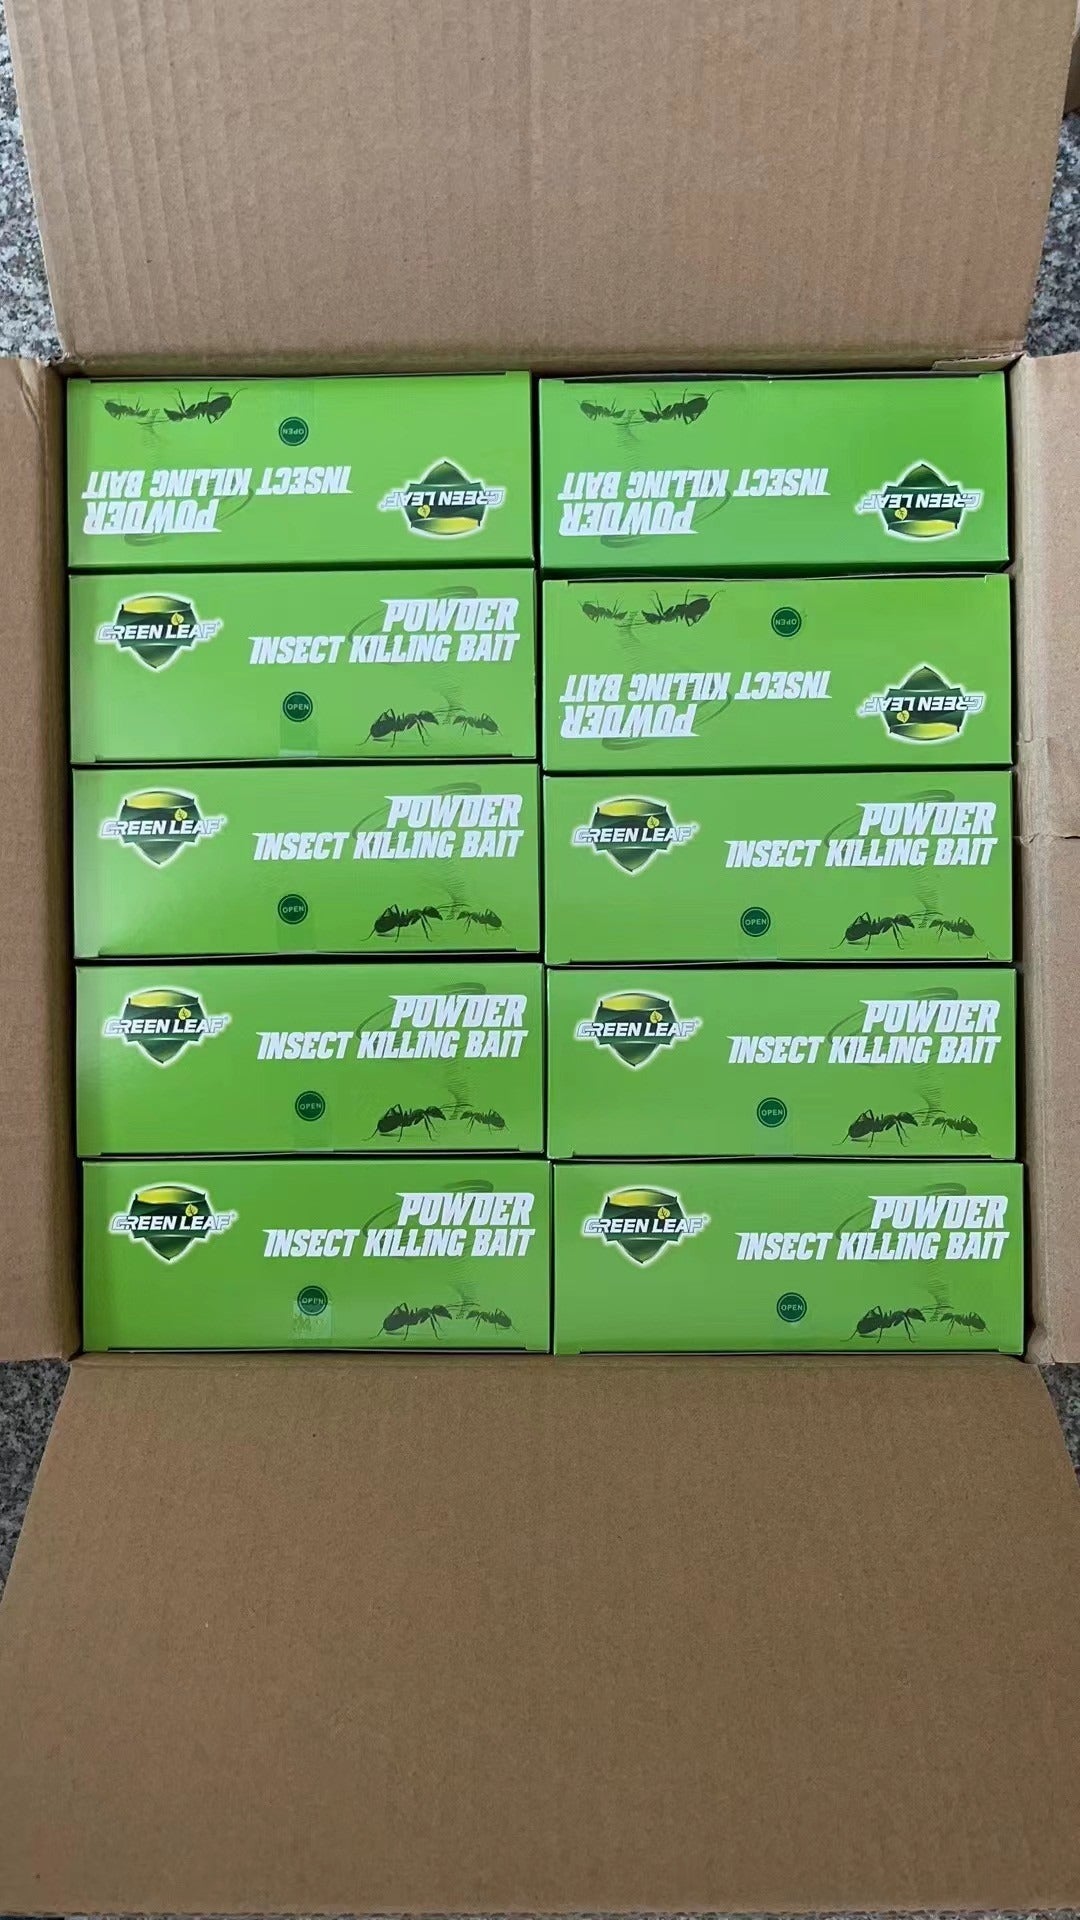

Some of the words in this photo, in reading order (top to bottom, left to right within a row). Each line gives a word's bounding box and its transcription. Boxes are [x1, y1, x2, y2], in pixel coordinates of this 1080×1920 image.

[81, 470, 144, 498] BAIT
[152, 468, 252, 496] KILLING
[256, 466, 352, 494] INSECT
[558, 472, 619, 500] BAIT
[627, 470, 729, 498] KILLING
[734, 468, 830, 496] INSECT
[382, 490, 436, 507] LEAF
[438, 490, 504, 506] GREEN
[859, 493, 912, 510] LEAF
[915, 493, 981, 509] GREEN
[83, 499, 221, 534] POWDER
[559, 501, 697, 536] POWDER
[380, 598, 519, 632] POWDER
[98, 624, 163, 640] GREEN
[165, 623, 215, 639] LEAF
[249, 636, 344, 664] INSECT
[348, 634, 452, 663] KILLING
[457, 633, 520, 661] BAIT
[560, 674, 624, 702] BAIT
[628, 672, 730, 701] KILLING
[735, 671, 832, 699] INSECT
[863, 696, 916, 713] LEAF
[918, 696, 984, 712] GREEN
[561, 704, 699, 738] POWDER
[384, 795, 523, 828] POWDER
[856, 802, 996, 836] POWDER
[101, 821, 167, 836] GREEN
[170, 820, 221, 836] LEAF
[572, 828, 639, 843] GREEN
[641, 826, 691, 843] LEAF
[253, 832, 349, 860] INSECT
[353, 831, 456, 859] KILLING
[460, 830, 524, 858] BAIT
[724, 840, 820, 868] INSECT
[825, 839, 927, 867] KILLING
[934, 838, 998, 866] BAIT
[389, 995, 527, 1028] POWDER
[860, 1000, 1001, 1033] POWDER
[104, 1020, 170, 1034] GREEN
[173, 1019, 225, 1035] LEAF
[576, 1022, 643, 1037] GREEN
[645, 1021, 695, 1037] LEAF
[256, 1032, 353, 1060] INSECT
[357, 1030, 460, 1059] KILLING
[464, 1030, 528, 1058] BAIT
[727, 1036, 824, 1064] INSECT
[828, 1036, 931, 1064] KILLING
[937, 1036, 1001, 1064] BAIT
[112, 1216, 178, 1230] GREEN
[180, 1215, 231, 1231] LEAF
[396, 1192, 535, 1226] POWDER
[868, 1195, 1008, 1229] POWDER
[584, 1218, 650, 1234] GREEN
[652, 1218, 703, 1234] LEAF
[263, 1229, 360, 1258] INSECT
[363, 1229, 467, 1257] KILLING
[471, 1229, 535, 1257] BAIT
[736, 1232, 833, 1261] INSECT
[837, 1232, 940, 1260] KILLING
[945, 1232, 1009, 1260] BAIT
